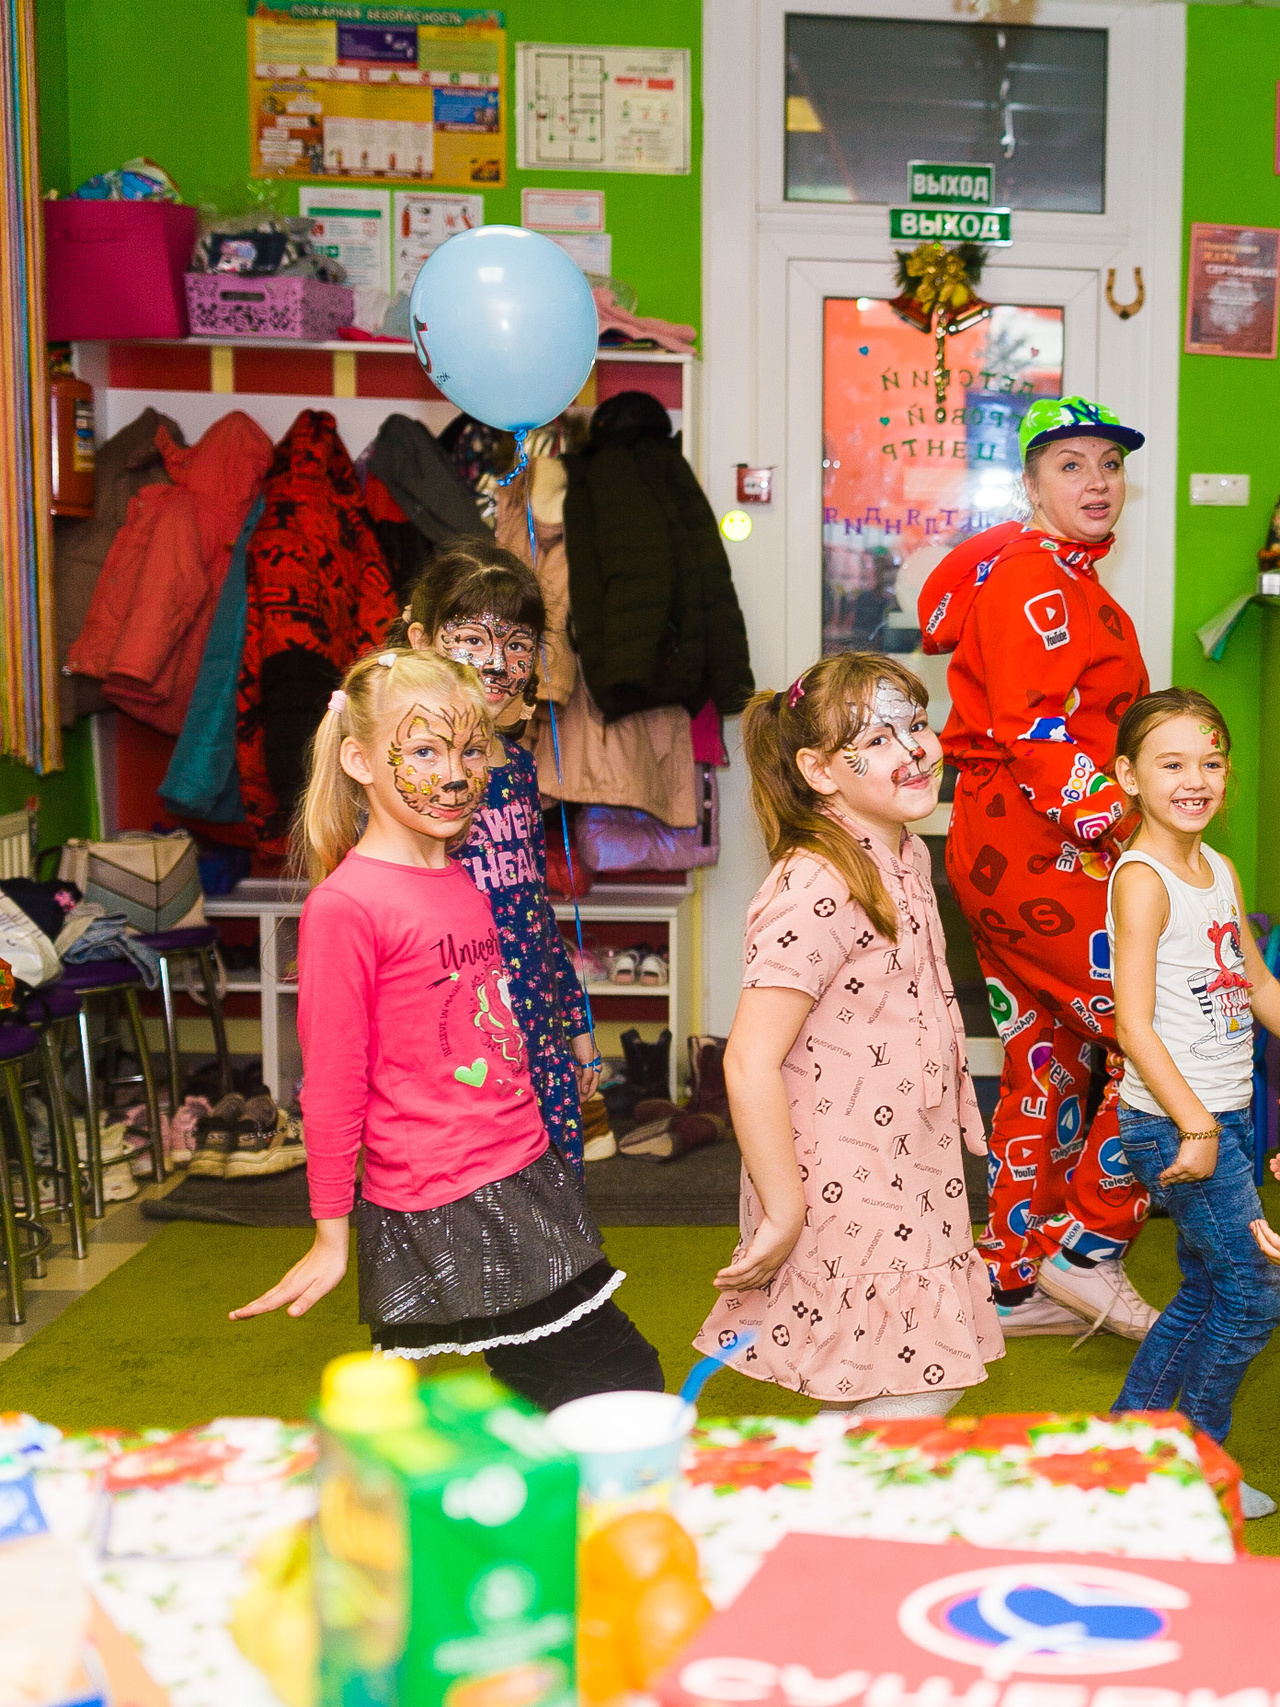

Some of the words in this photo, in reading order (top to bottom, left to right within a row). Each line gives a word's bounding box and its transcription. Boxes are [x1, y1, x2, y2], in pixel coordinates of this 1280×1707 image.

[913, 173, 989, 201] ВЫХОД
[900, 212, 1001, 239] ВЫХОД
[1044, 630, 1068, 648] YouTube
[439, 1021, 453, 1057] BELIEVE
[812, 1037, 853, 1058] OUISVUITTON
[844, 1076, 865, 1117] LOUISVUITTON
[838, 1135, 880, 1153] LOUISVUITTON
[1013, 1166, 1036, 1179] YouTu
[1101, 1174, 1136, 1188] Telegr
[859, 1228, 885, 1268] LOUISVUITTON
